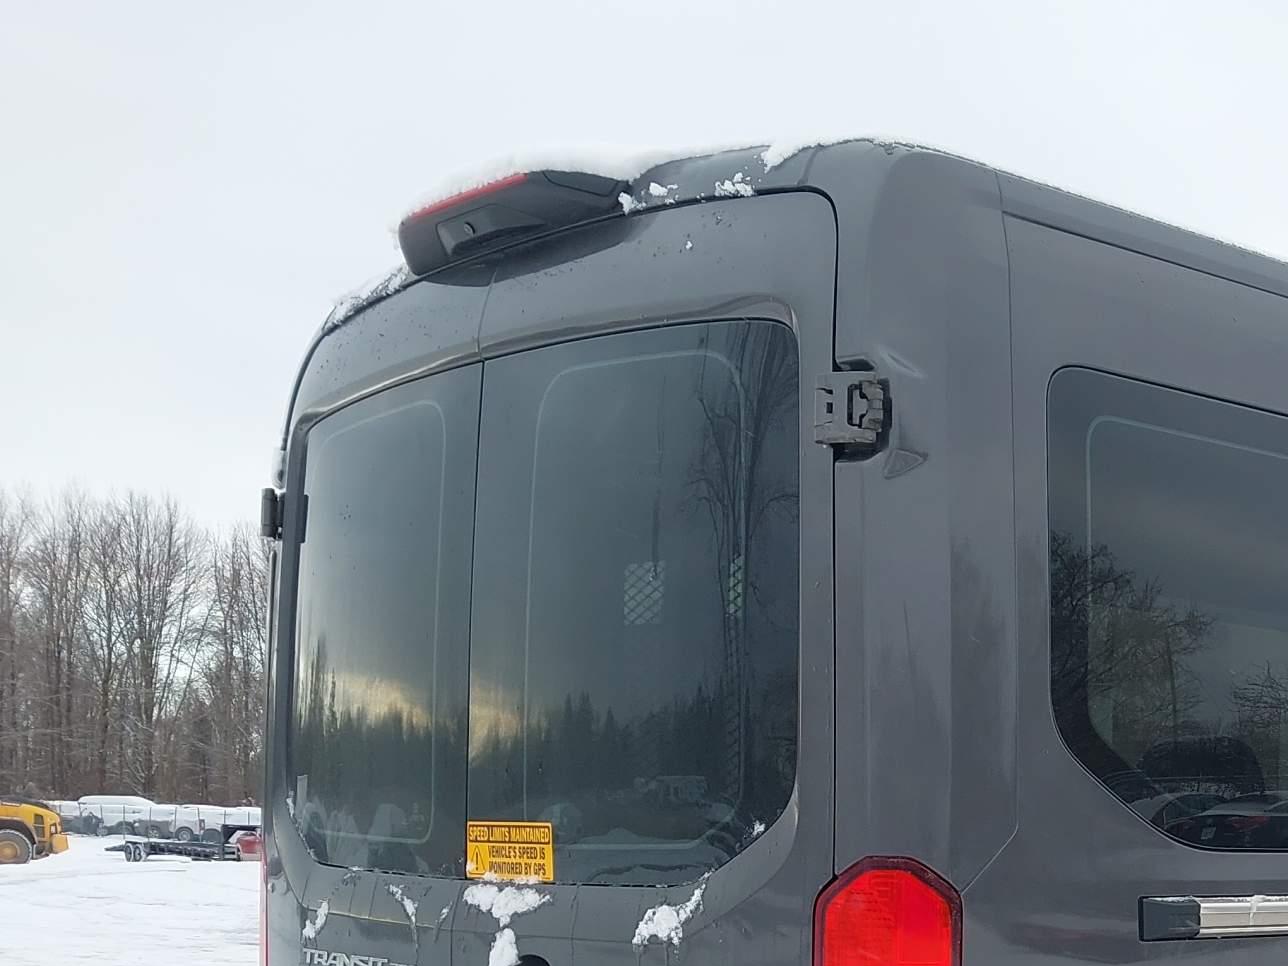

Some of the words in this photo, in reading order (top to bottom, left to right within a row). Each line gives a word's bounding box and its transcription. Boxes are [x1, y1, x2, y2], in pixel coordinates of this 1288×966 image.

[469, 826, 489, 841] SPEED
[489, 826, 509, 842] LIMITS
[510, 826, 549, 843] MAINTAINED
[488, 845, 517, 859] VEHICLE'S
[518, 846, 538, 860] SPEED
[539, 847, 546, 860] IS
[489, 861, 522, 875] MONITORED
[523, 862, 532, 876] BY
[533, 863, 546, 876] GPS
